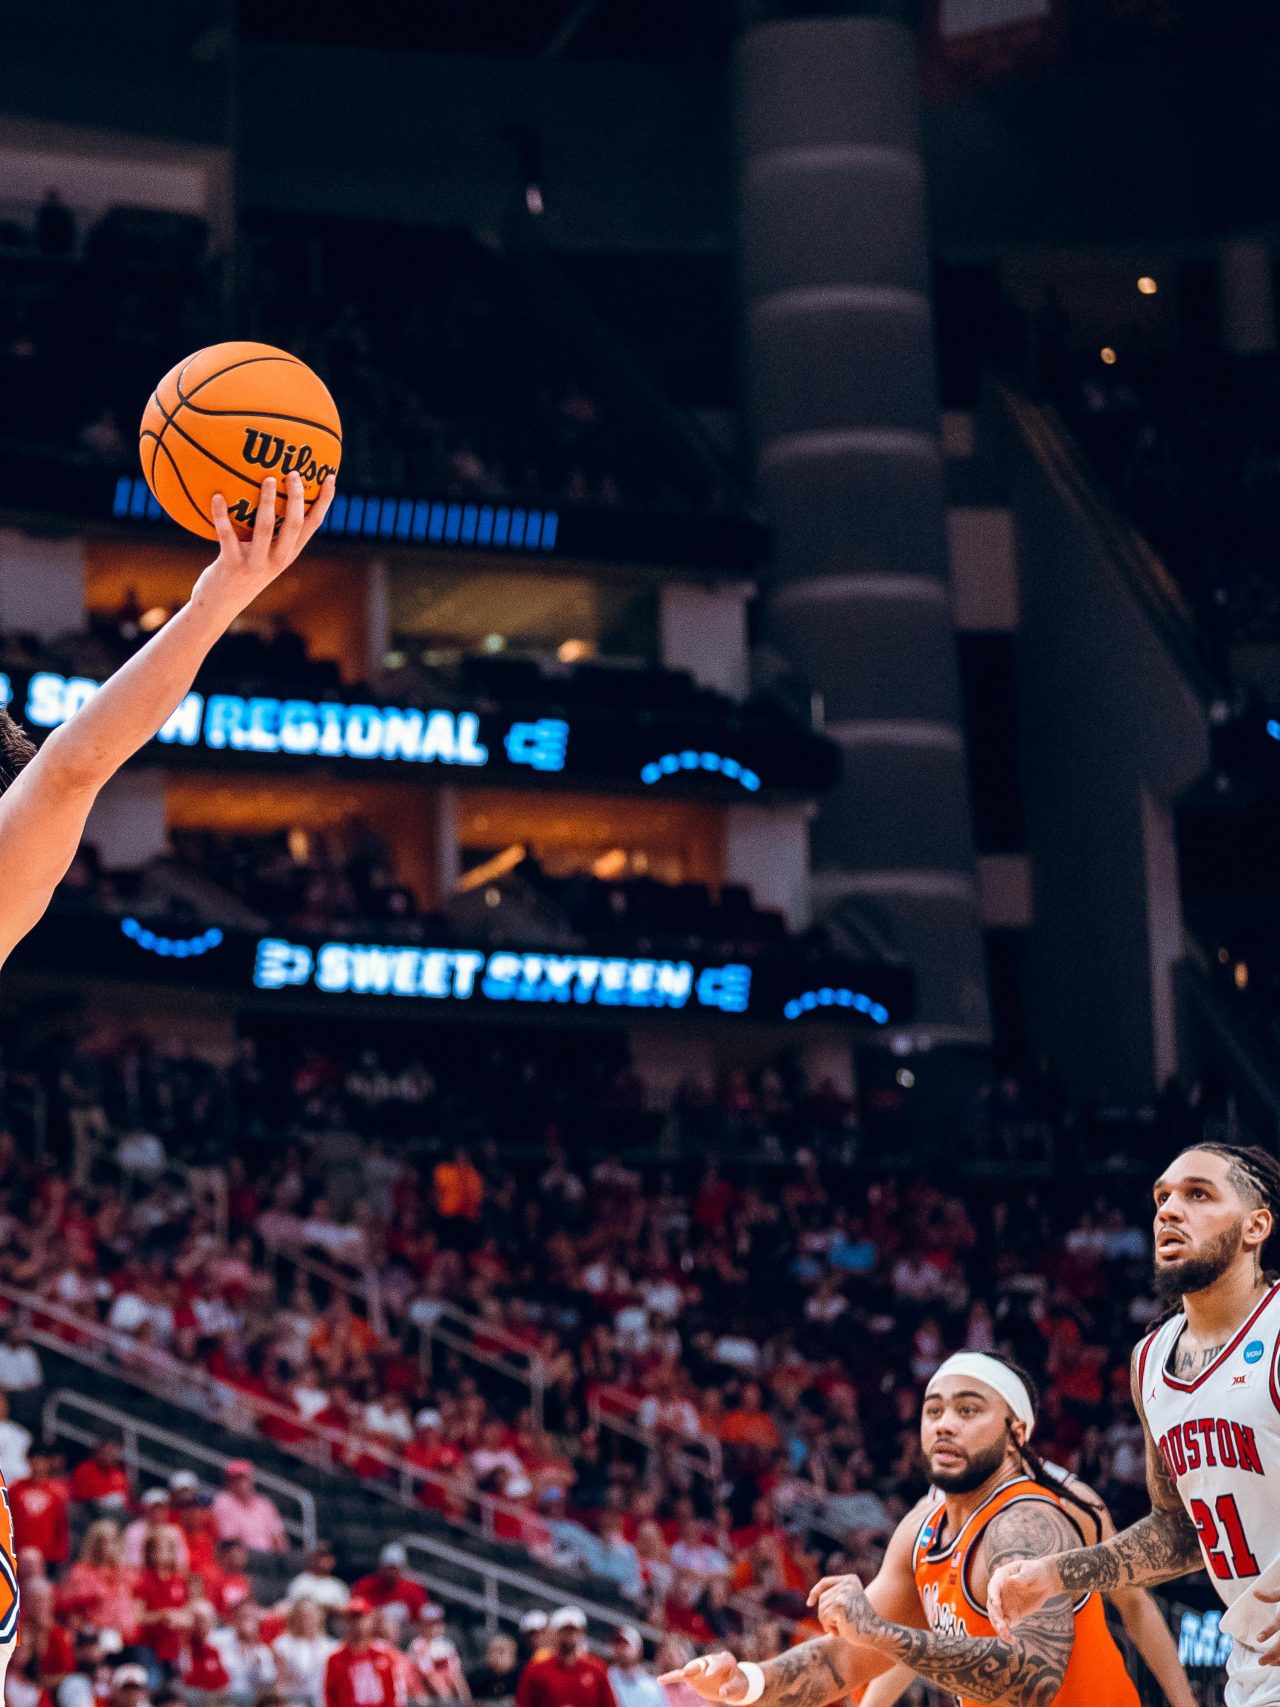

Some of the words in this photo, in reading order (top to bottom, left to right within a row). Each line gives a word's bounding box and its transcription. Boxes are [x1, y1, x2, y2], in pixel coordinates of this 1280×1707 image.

[24, 671, 204, 746] SOH
[205, 695, 488, 766] REGIONAL
[315, 942, 485, 999] SWEET
[482, 951, 693, 1009] SIXTEEN
[1190, 1493, 1262, 1580] 21
